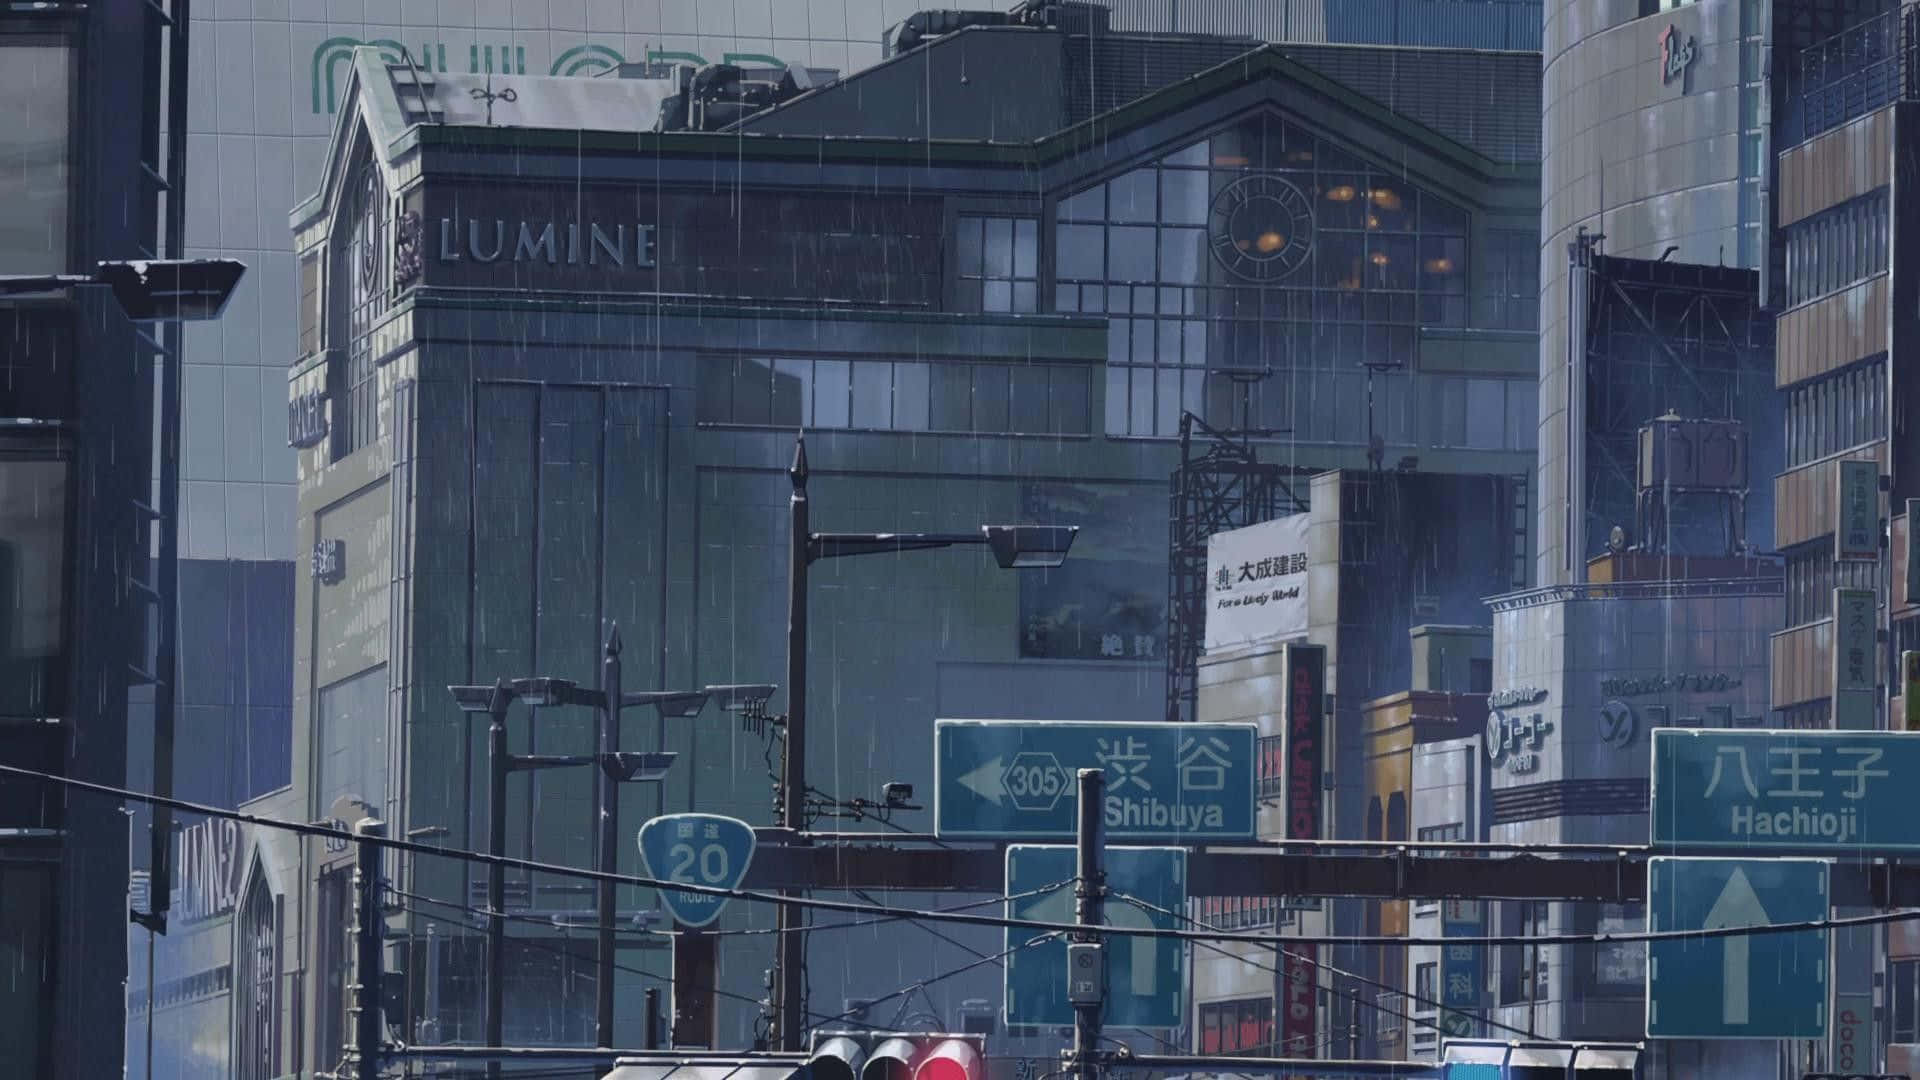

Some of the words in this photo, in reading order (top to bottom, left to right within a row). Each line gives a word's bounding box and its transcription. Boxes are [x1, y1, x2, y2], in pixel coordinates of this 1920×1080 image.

[440, 217, 657, 268] LUMINE
[1238, 552, 1308, 583] 大成建設
[1011, 765, 1060, 797] 305
[1096, 736, 1233, 792] 渋谷
[1703, 745, 1890, 799] 八王子
[1104, 795, 1224, 832] Shibuya
[1731, 805, 1857, 843] Hachioji
[669, 843, 728, 883] 20
